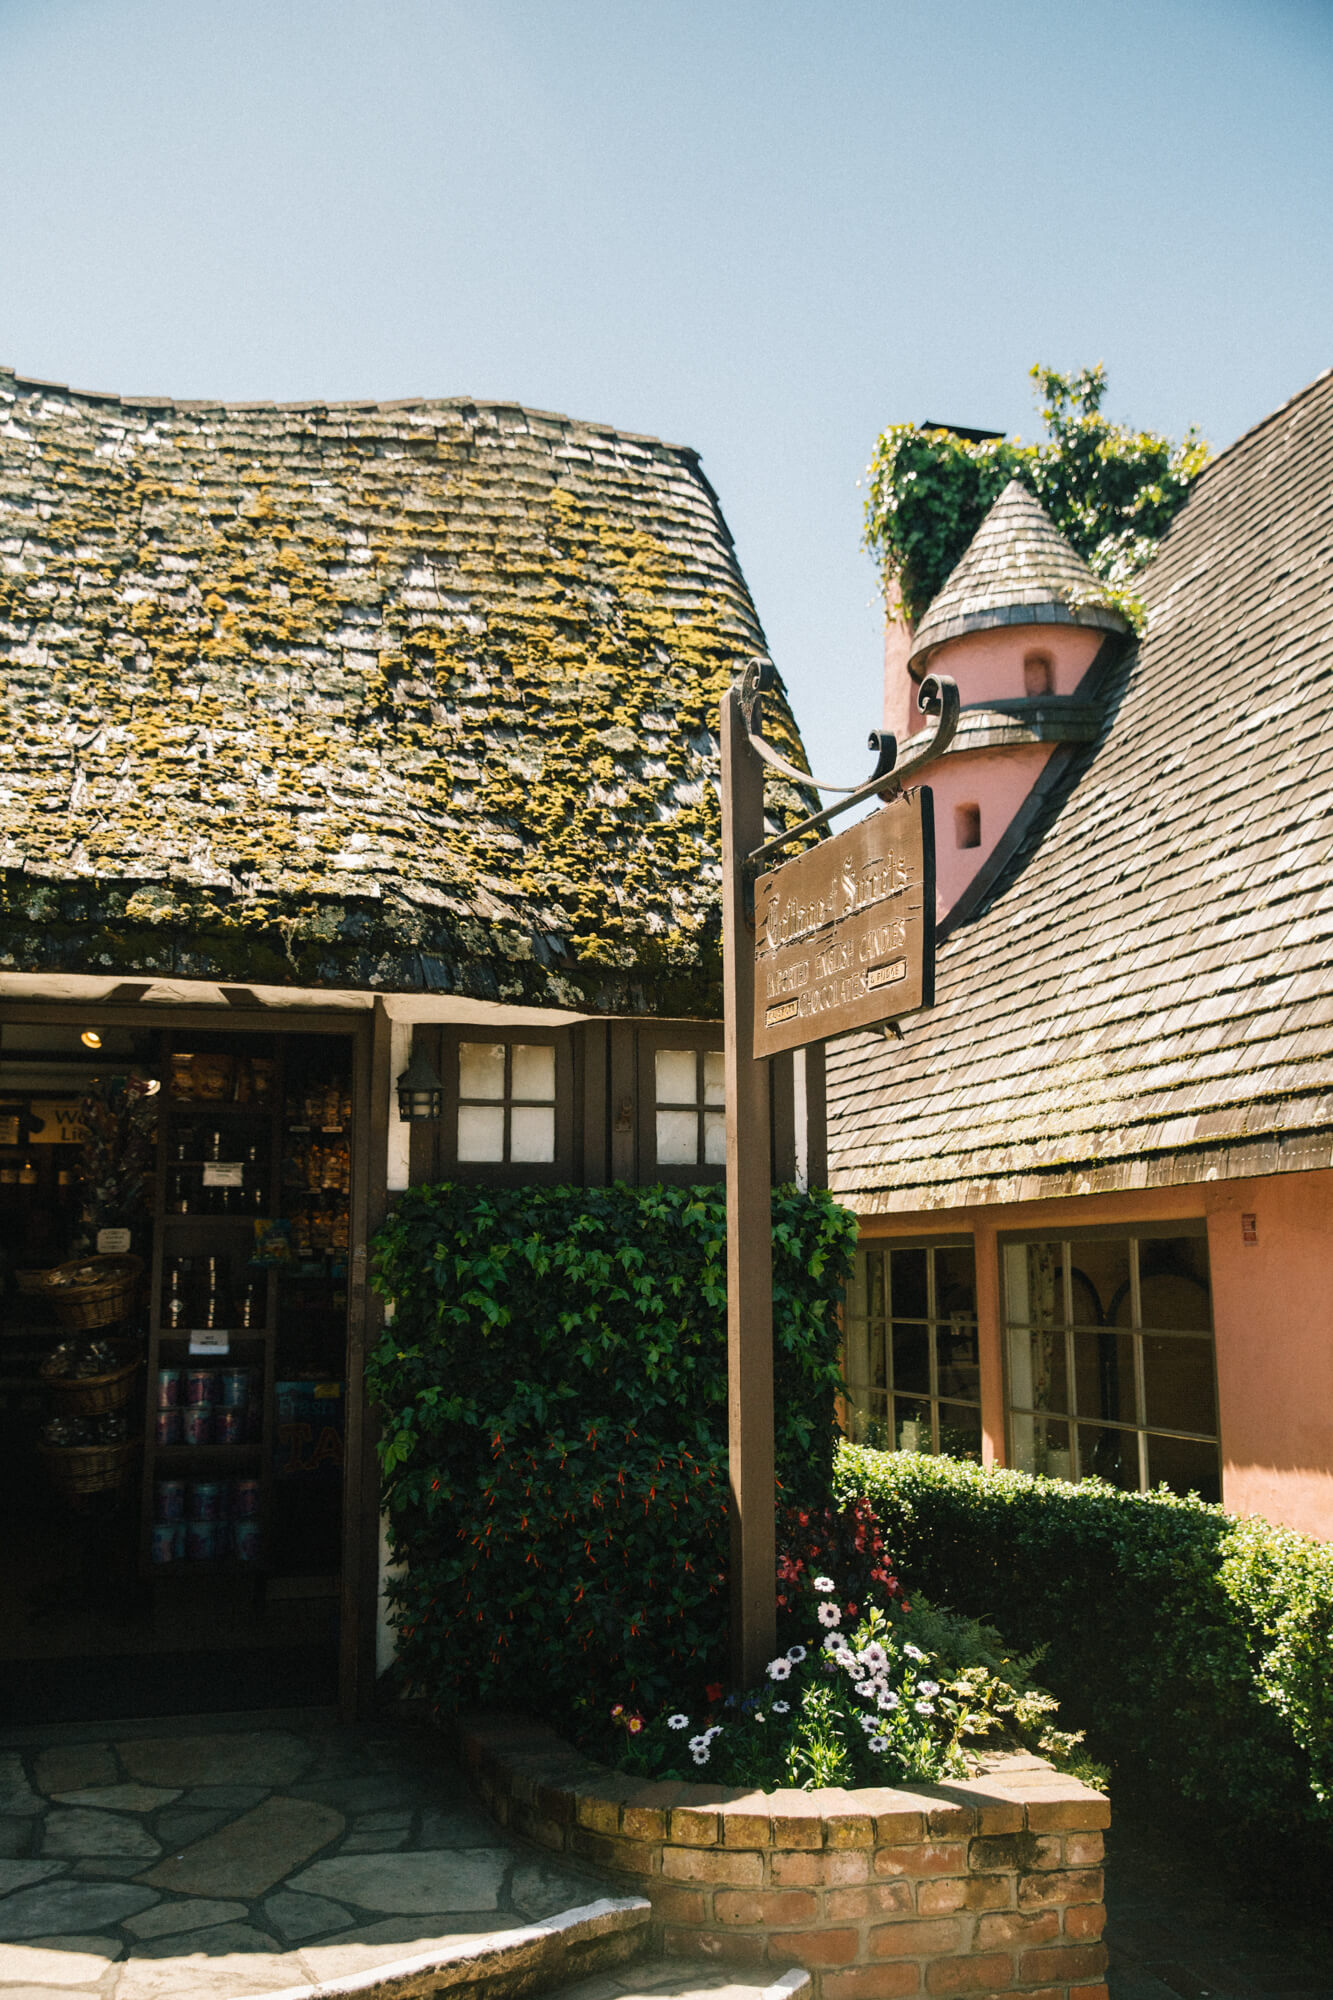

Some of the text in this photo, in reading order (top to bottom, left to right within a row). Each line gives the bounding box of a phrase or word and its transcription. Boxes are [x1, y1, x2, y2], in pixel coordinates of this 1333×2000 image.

[859, 920, 906, 962] CANDIES
[799, 969, 866, 1017] CHOCOLATES
[877, 966, 900, 981] FUDGE
